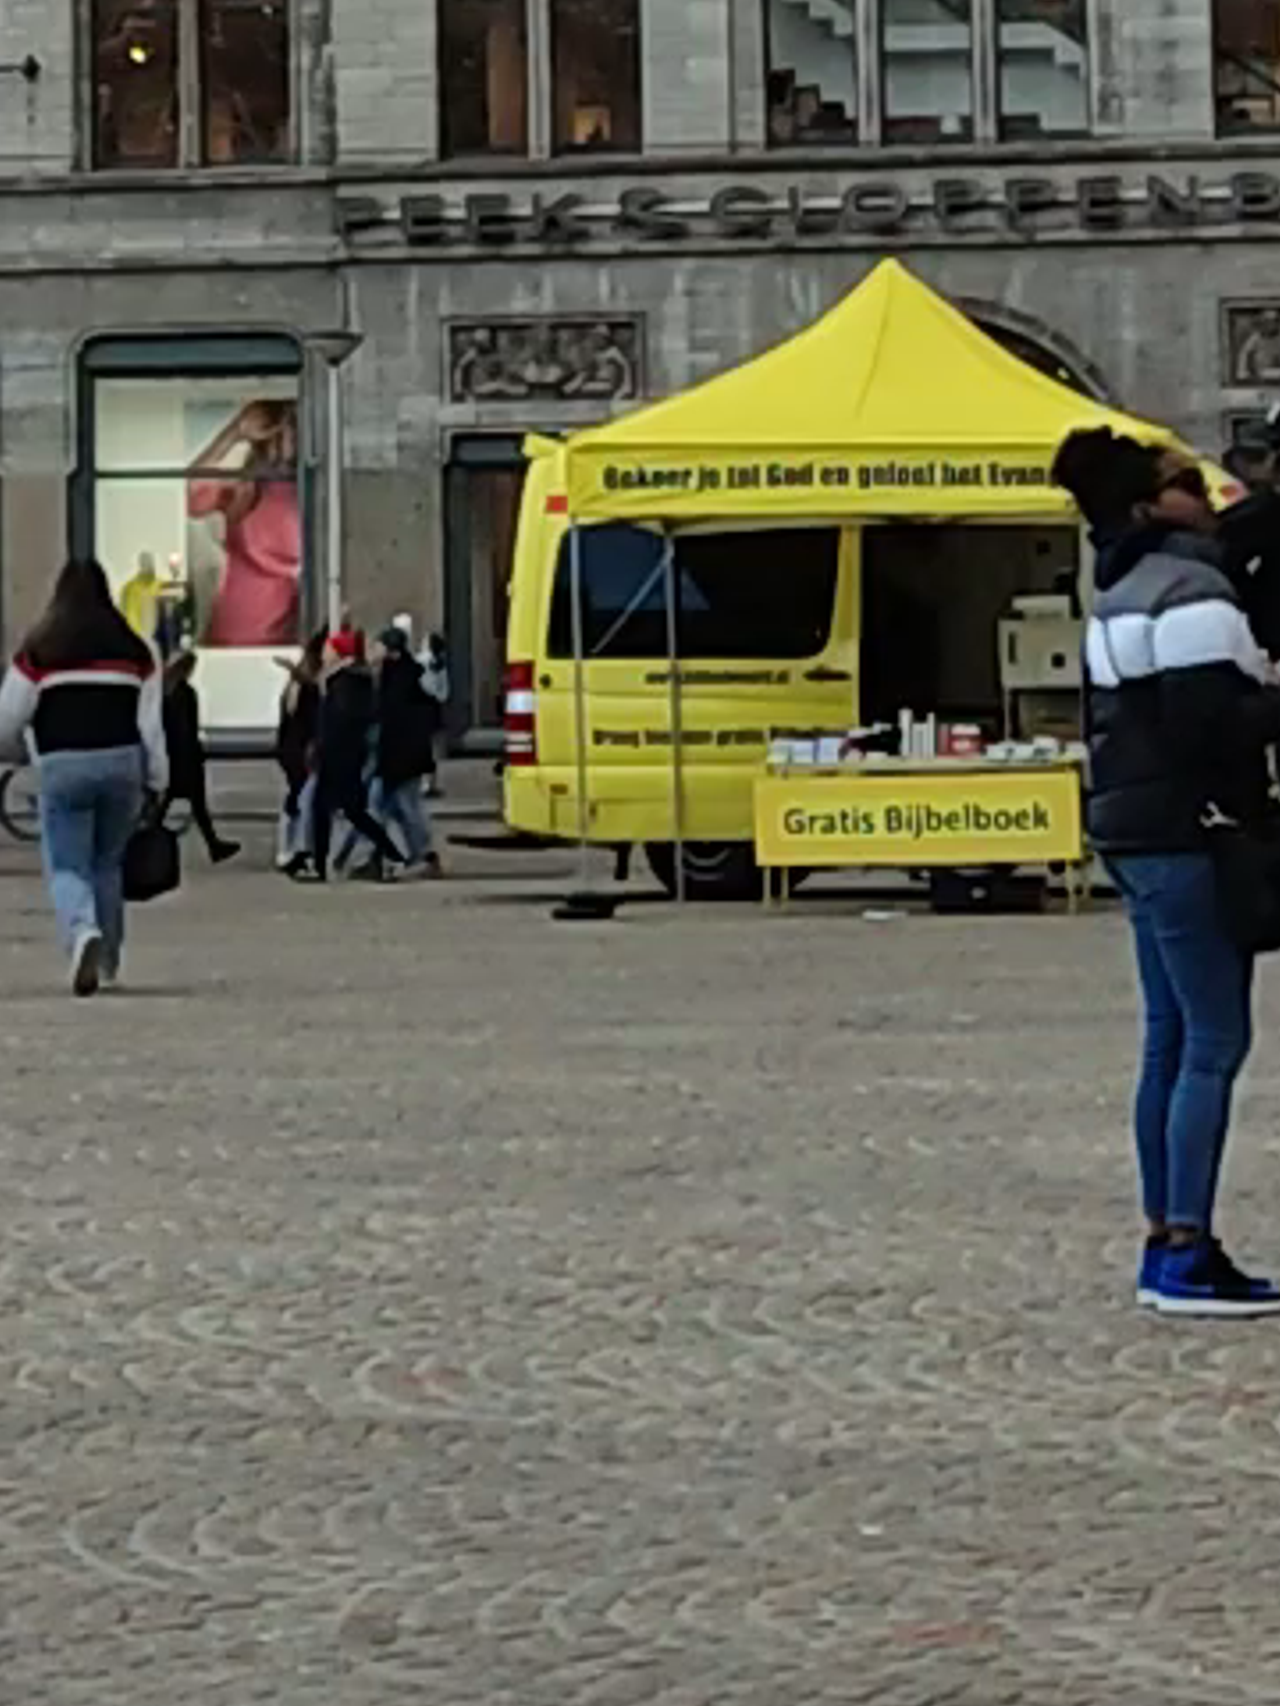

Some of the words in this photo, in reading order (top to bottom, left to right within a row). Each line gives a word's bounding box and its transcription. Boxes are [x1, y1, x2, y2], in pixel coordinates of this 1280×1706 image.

[766, 462, 814, 487] God
[782, 806, 875, 835] Gratis
[884, 801, 1050, 839] Bijbelboek
